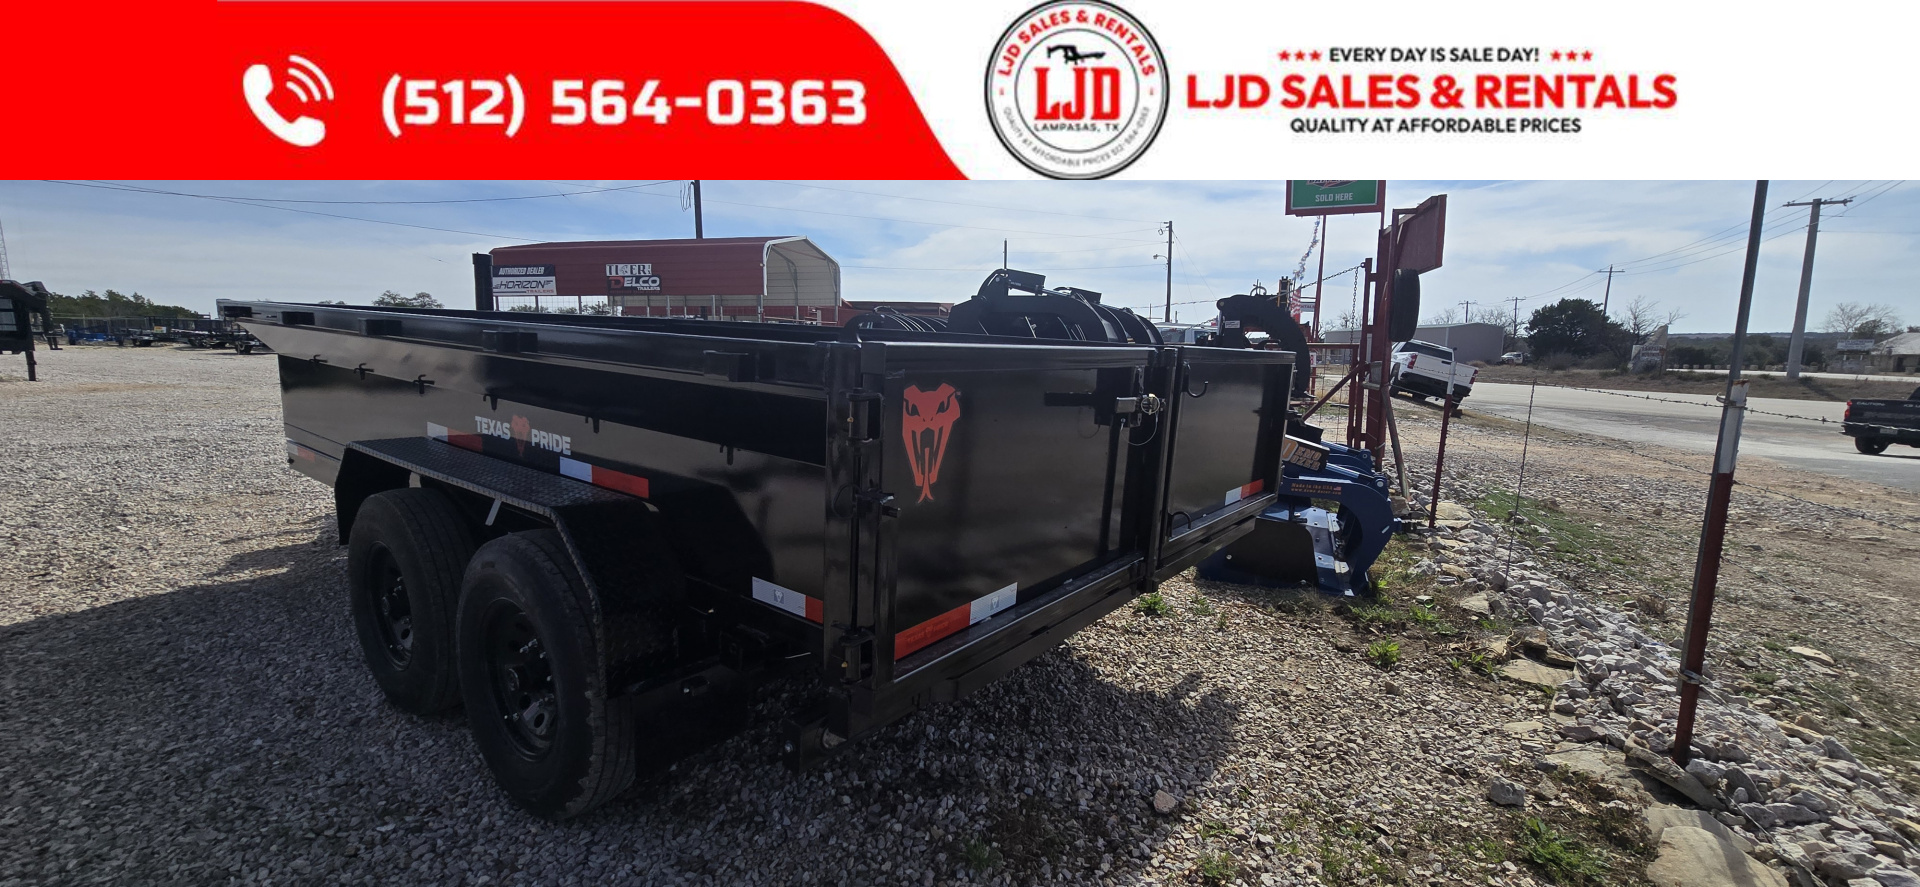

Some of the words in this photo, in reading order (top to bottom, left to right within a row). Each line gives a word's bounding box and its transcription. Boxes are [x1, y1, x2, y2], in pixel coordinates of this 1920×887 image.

[1315, 194, 1333, 202] SOLD
[1335, 193, 1354, 201] HERE
[499, 280, 546, 289] HORIZON
[609, 276, 660, 288] DELCO
[474, 415, 511, 441] TEXAS
[531, 428, 571, 456] PRIDE
